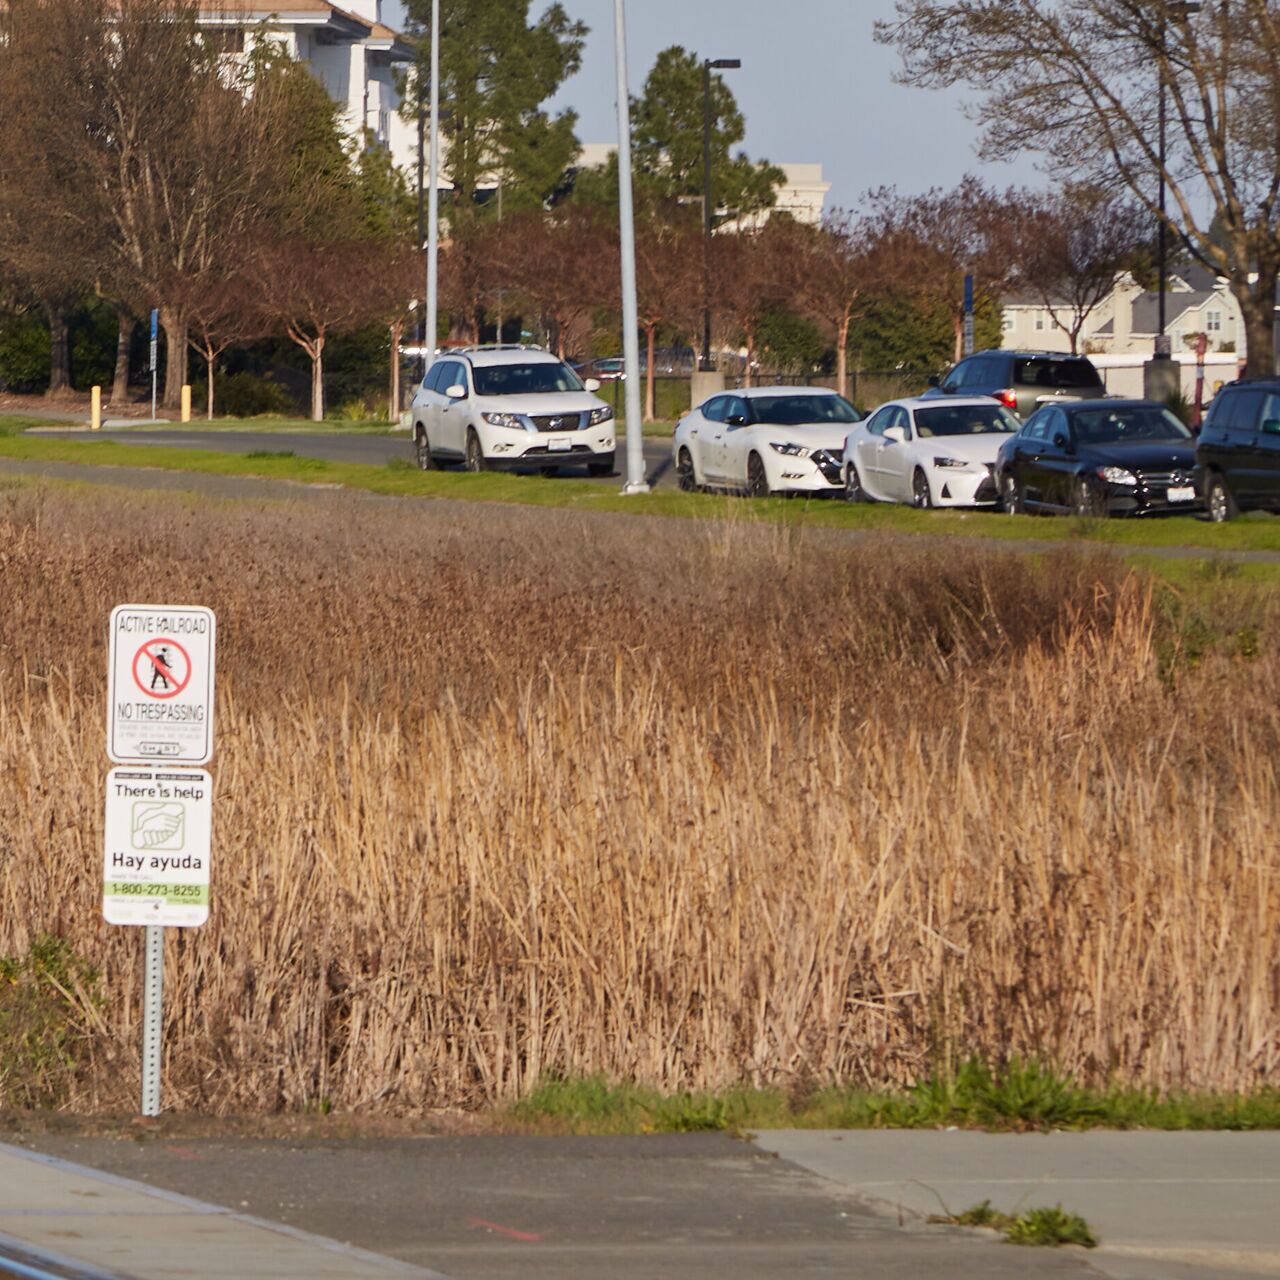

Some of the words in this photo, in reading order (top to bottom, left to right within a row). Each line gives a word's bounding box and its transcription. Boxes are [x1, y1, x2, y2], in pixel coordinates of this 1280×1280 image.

[119, 616, 153, 633] ACTIVE
[156, 616, 206, 634] RAILROAD
[118, 703, 132, 719] NO
[136, 704, 204, 721] TRESPASSING
[115, 784, 156, 797] There
[159, 786, 170, 798] is
[174, 786, 204, 801] help
[113, 852, 144, 871] Hay
[150, 854, 202, 872] ayuda
[113, 883, 201, 897] 1-800-273-8255
